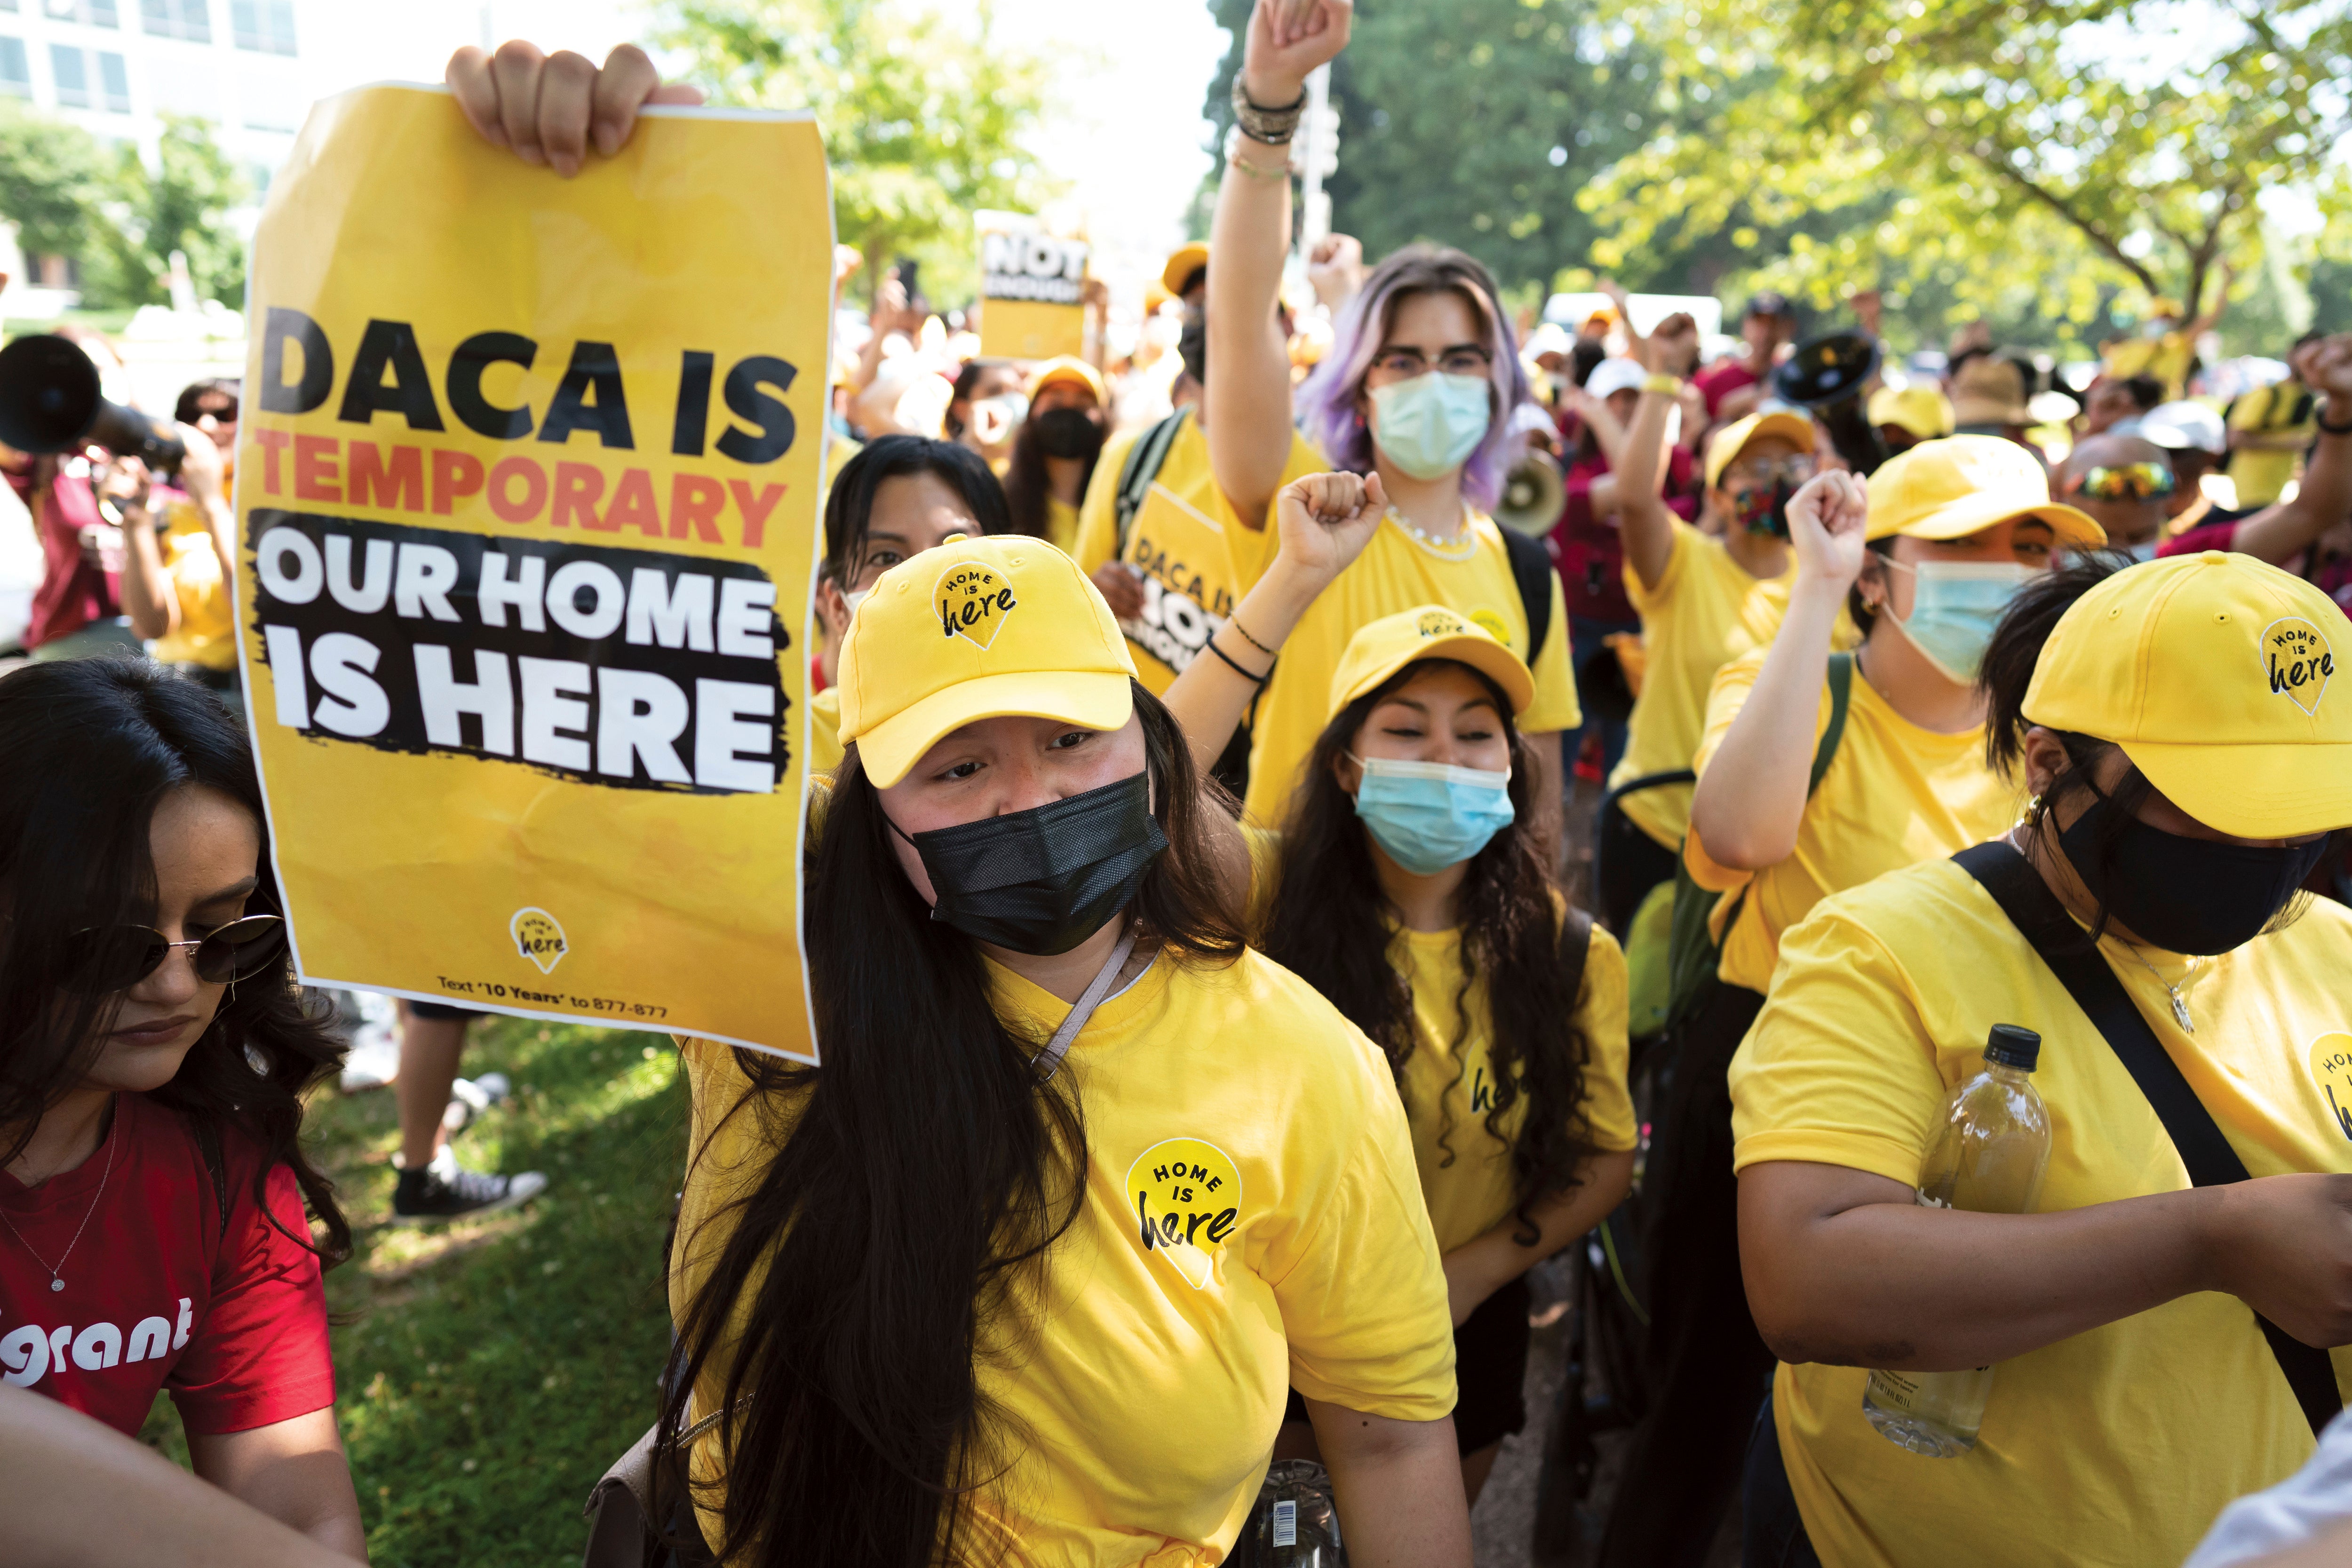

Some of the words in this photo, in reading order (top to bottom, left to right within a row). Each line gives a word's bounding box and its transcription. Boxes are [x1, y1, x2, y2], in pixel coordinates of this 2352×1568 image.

[984, 233, 1089, 278] NOT
[258, 306, 635, 450] DACA
[670, 350, 798, 465] IS
[254, 427, 788, 549] TEMPORARY
[946, 572, 993, 591] HOME
[964, 585, 977, 595] IS
[1136, 538, 1203, 601] DACA
[256, 526, 462, 622] OUR
[477, 550, 777, 659] HOME
[943, 588, 1017, 637] here
[2273, 630, 2317, 647] HOME
[2292, 645, 2306, 654] IS
[2269, 653, 2334, 693] here
[263, 623, 391, 737] IS
[413, 643, 776, 794] HERE
[520, 931, 565, 955] here
[524, 918, 552, 931] HOME
[437, 975, 474, 994] Text
[571, 995, 589, 1009] to
[592, 997, 667, 1019] 877-877
[1153, 1162, 1223, 1193] HOME
[1172, 1186, 1194, 1203] IS
[1139, 1190, 1238, 1251] here
[0, 1297, 193, 1388] grant
